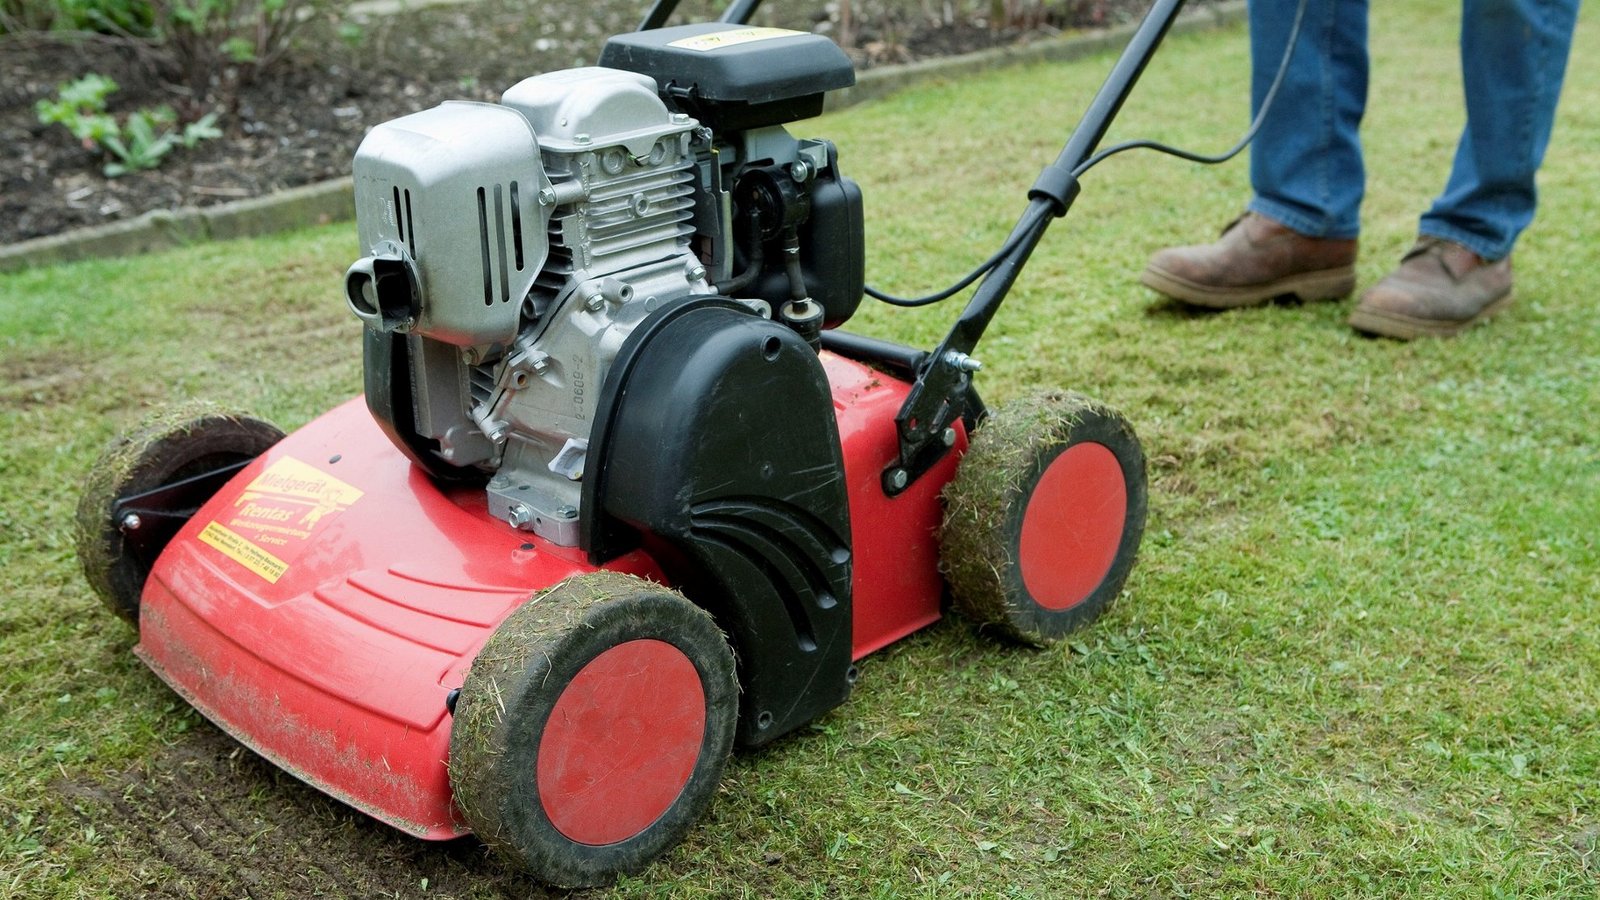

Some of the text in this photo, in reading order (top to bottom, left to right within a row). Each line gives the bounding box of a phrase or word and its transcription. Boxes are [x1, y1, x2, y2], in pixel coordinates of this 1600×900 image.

[258, 472, 327, 493] Mietgerät
[238, 502, 294, 521] Rentas
[259, 534, 288, 546] Service
